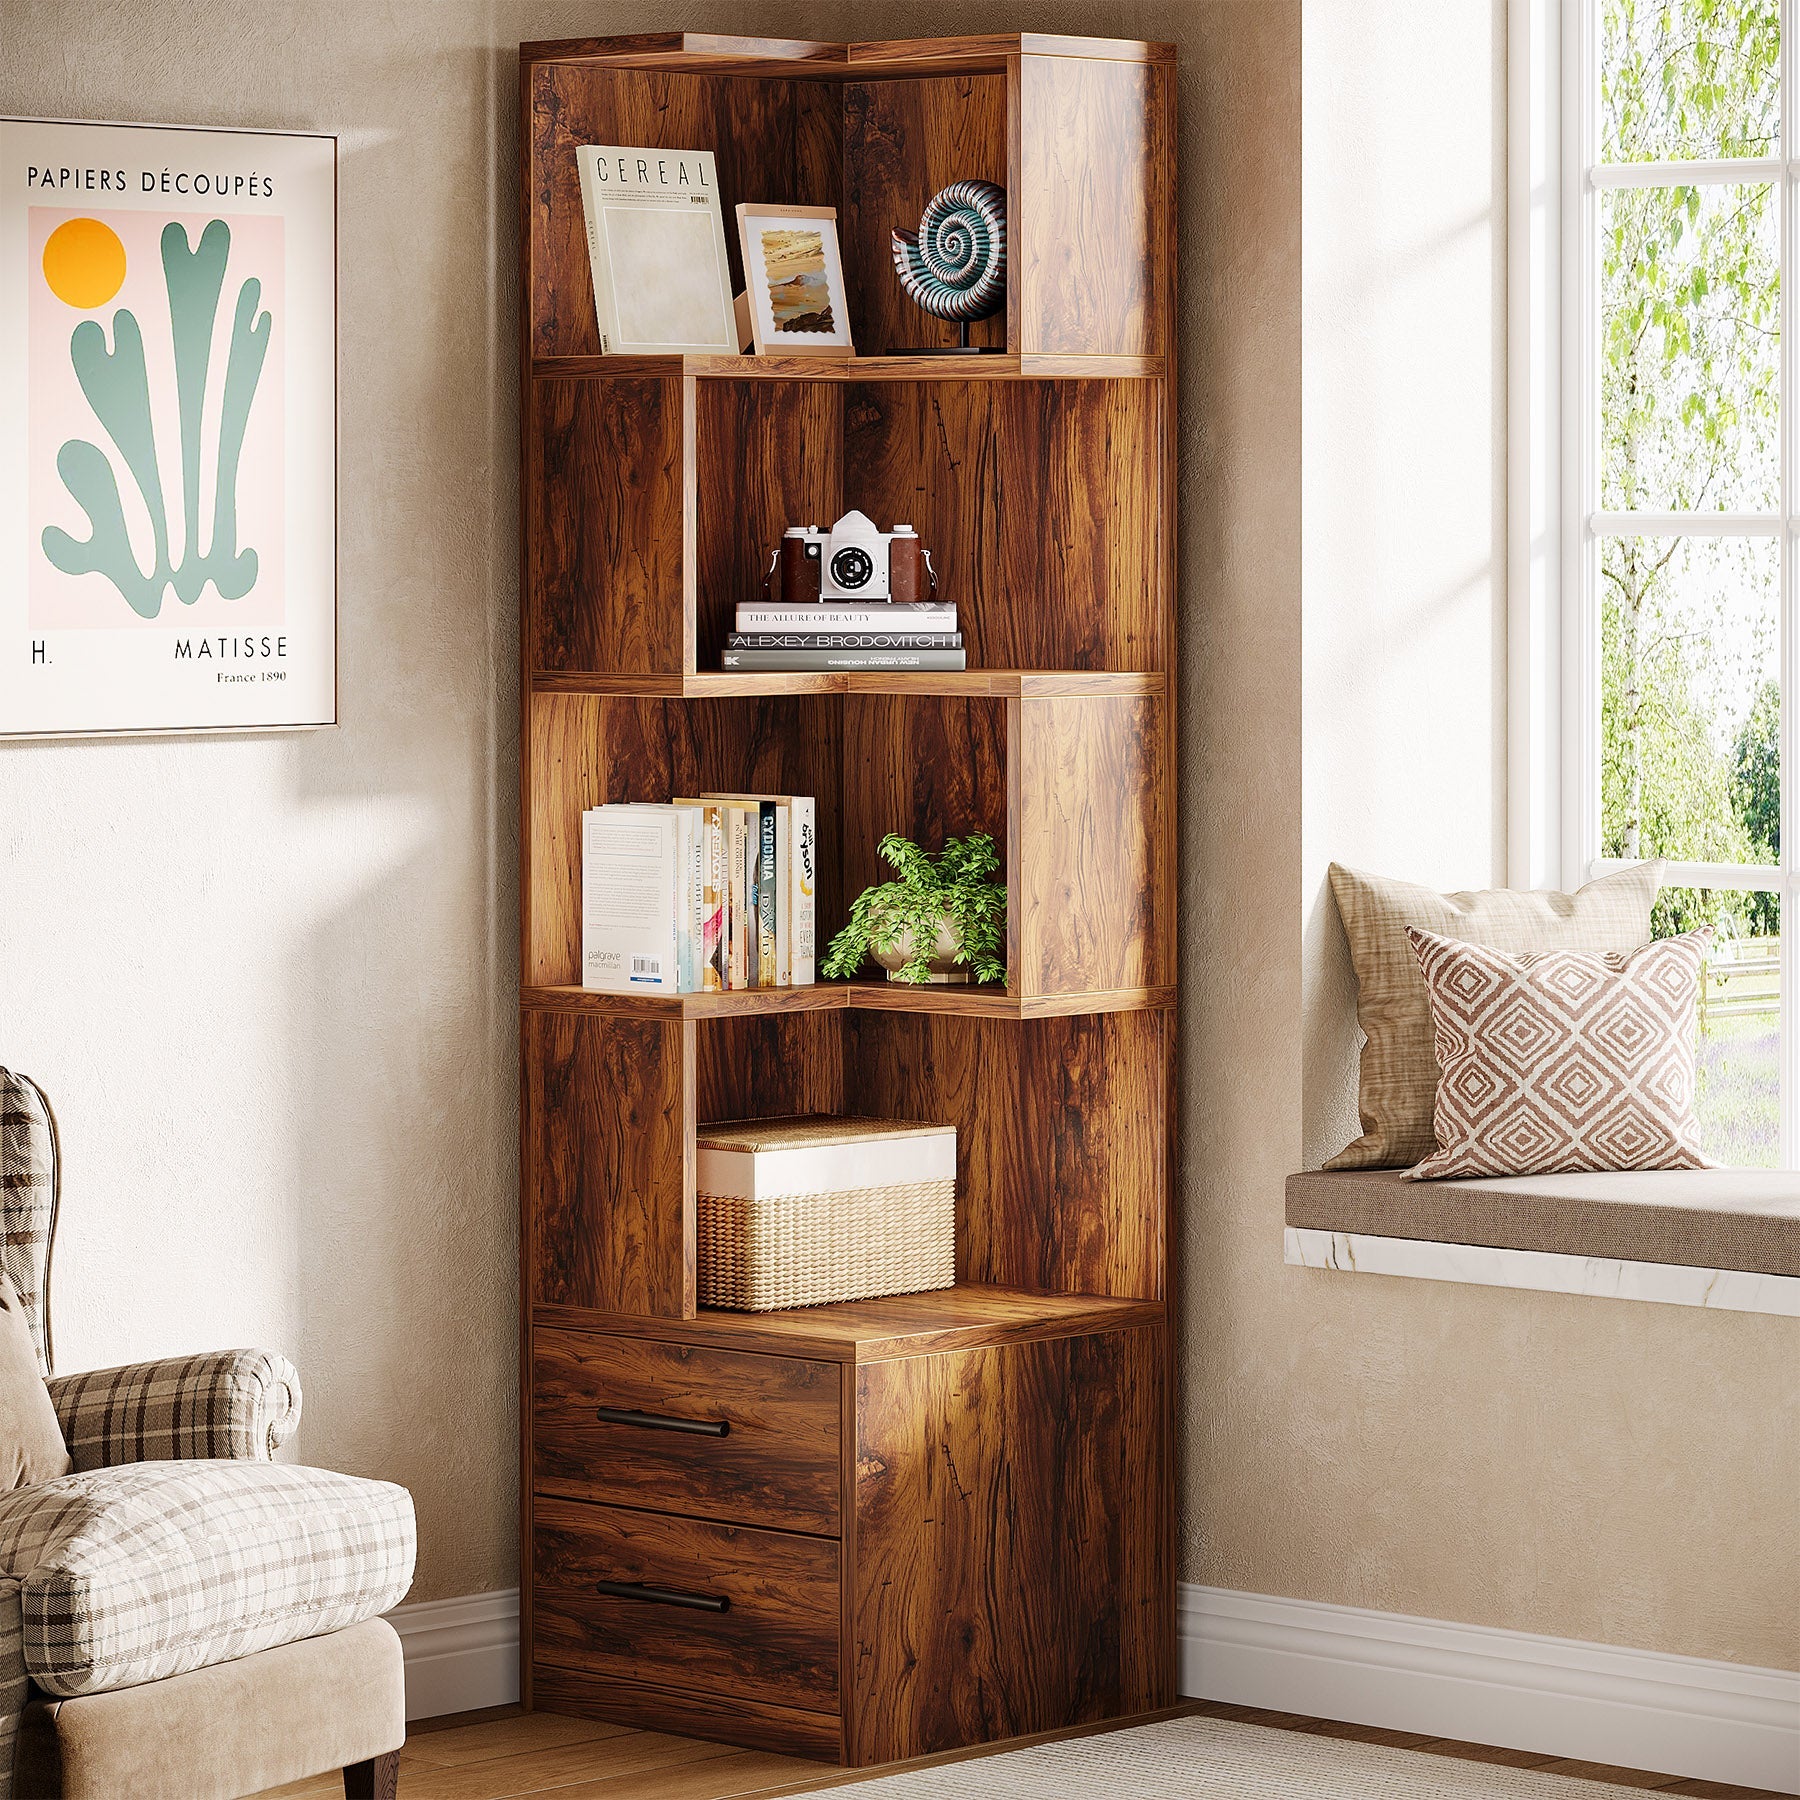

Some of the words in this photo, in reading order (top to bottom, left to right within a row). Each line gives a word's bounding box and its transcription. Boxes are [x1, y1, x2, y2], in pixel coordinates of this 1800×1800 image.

[597, 156, 709, 187] CEREAL
[27, 166, 127, 192] PAPIERS
[141, 167, 274, 198] DÉCOUPÉS
[829, 614, 871, 622] BEAUTY
[32, 640, 53, 664] H.
[174, 636, 287, 660] MATISSE
[732, 635, 811, 647] ALEXEY
[816, 635, 946, 647] BRODOVITCH
[217, 672, 256, 683] France
[260, 671, 287, 682] 1890
[764, 816, 774, 881] CYDONIA
[800, 823, 813, 880] bryson
[588, 949, 621, 962] palgrave
[588, 961, 621, 970] macmillan
